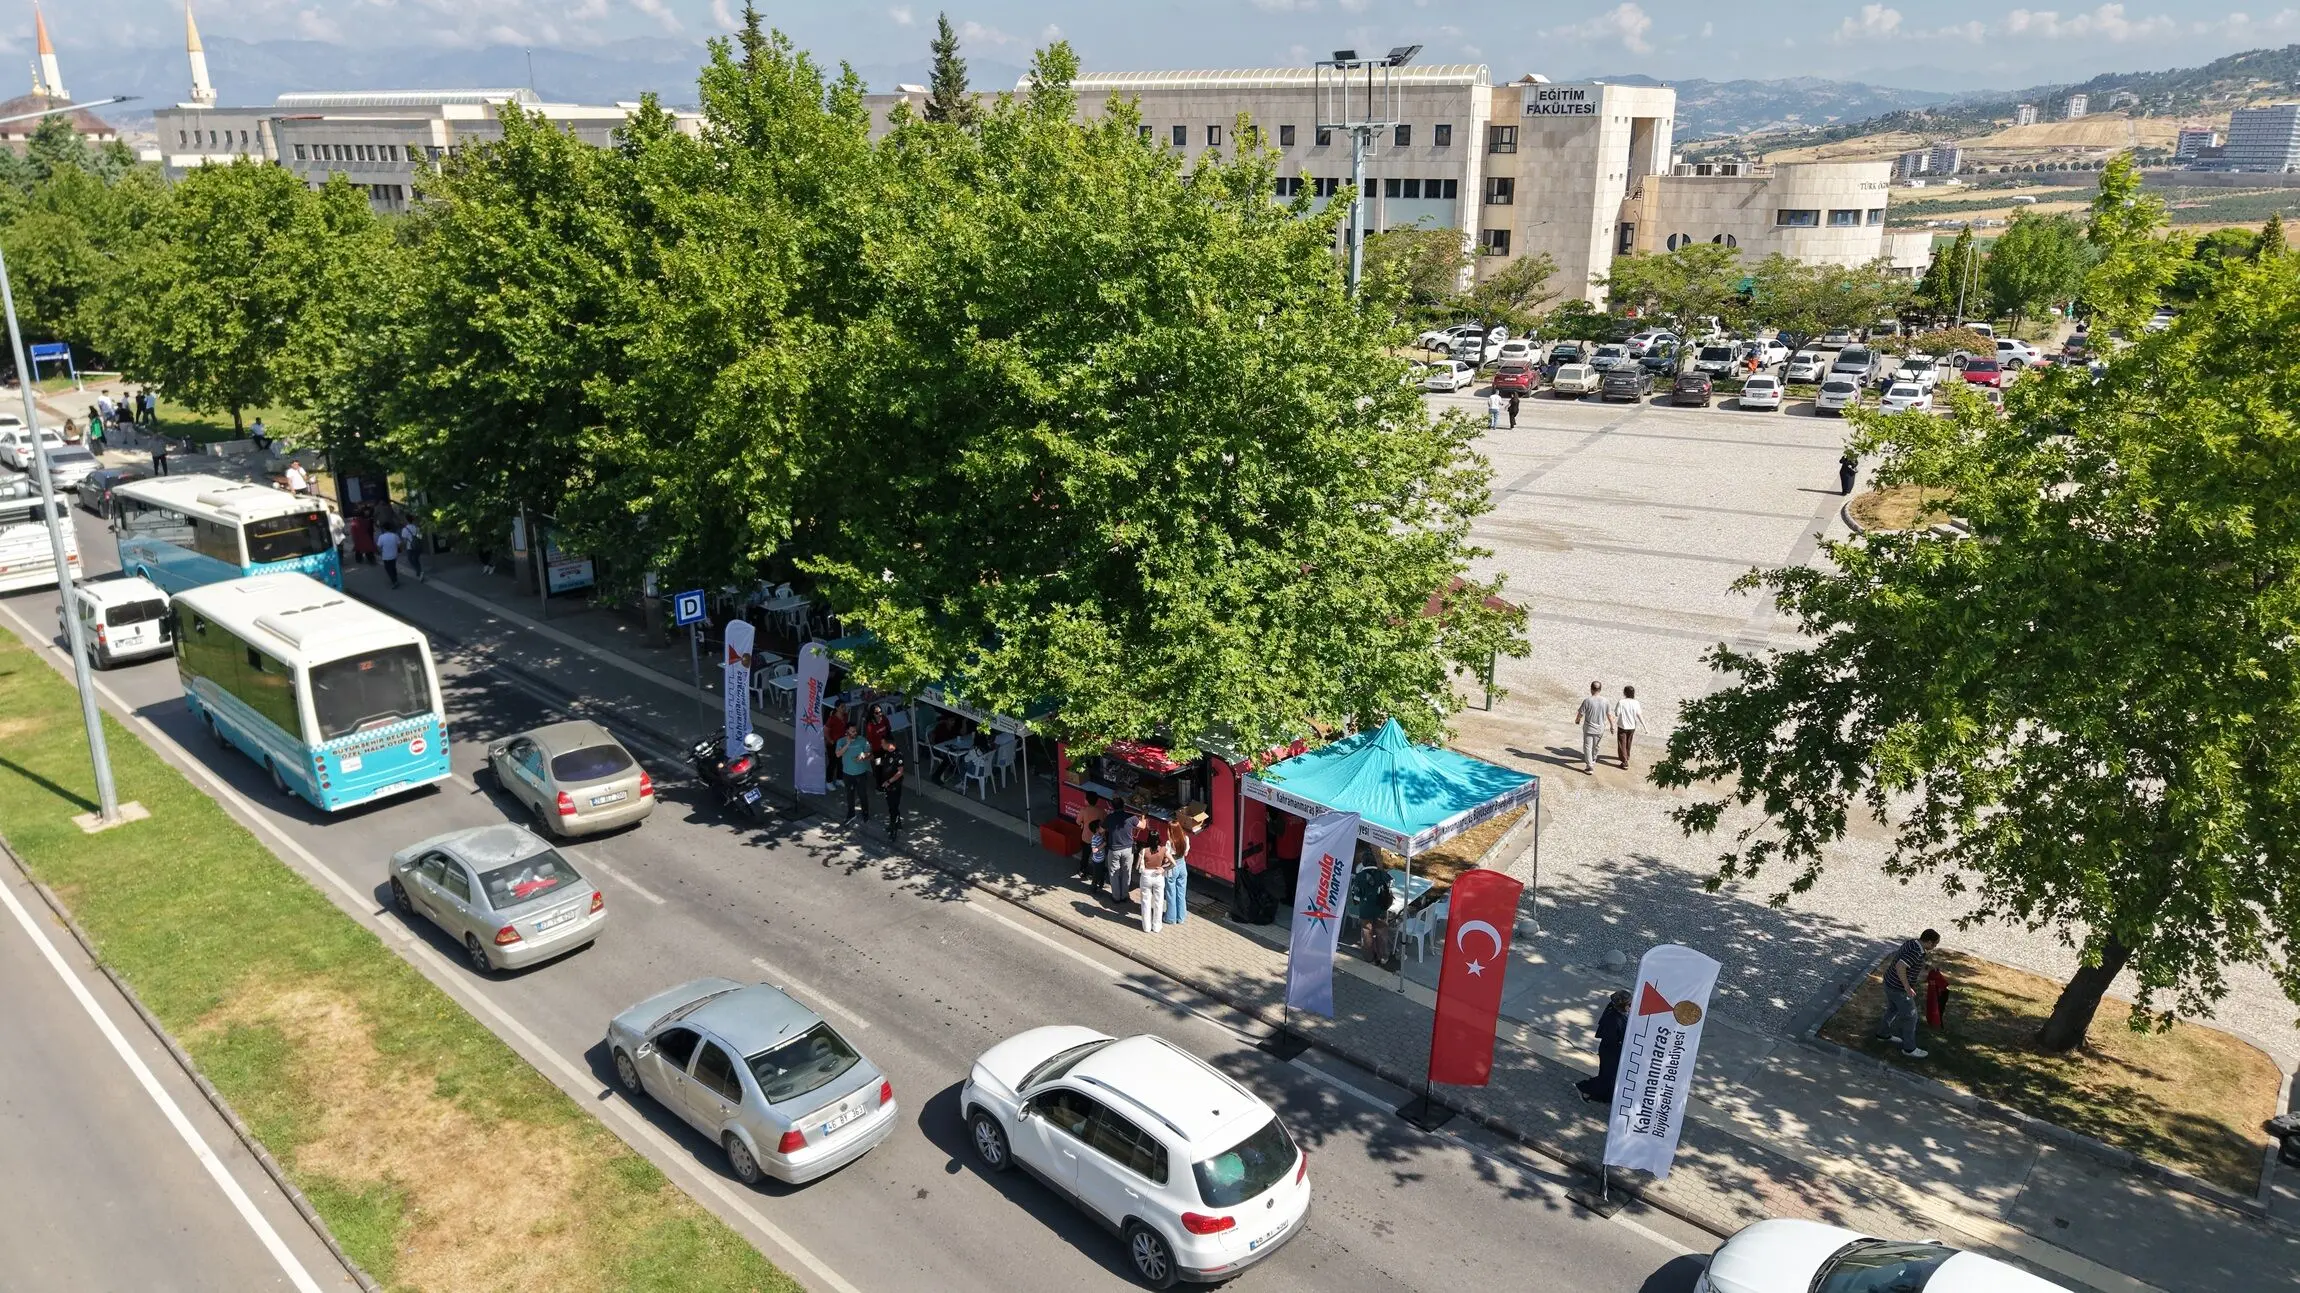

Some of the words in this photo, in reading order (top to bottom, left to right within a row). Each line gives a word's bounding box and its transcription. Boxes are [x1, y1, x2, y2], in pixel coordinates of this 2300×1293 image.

[1527, 101, 1596, 114] FAKÜLTESİ
[1540, 88, 1584, 101] EĞİTİM
[685, 598, 698, 616] D
[1316, 853, 1334, 912] pusula
[1328, 858, 1344, 906] maraş
[1633, 1026, 1672, 1134] Kahramanmaraş
[1652, 1084, 1674, 1138] Büyükşehir
[1664, 1030, 1686, 1082] Belediyesi
